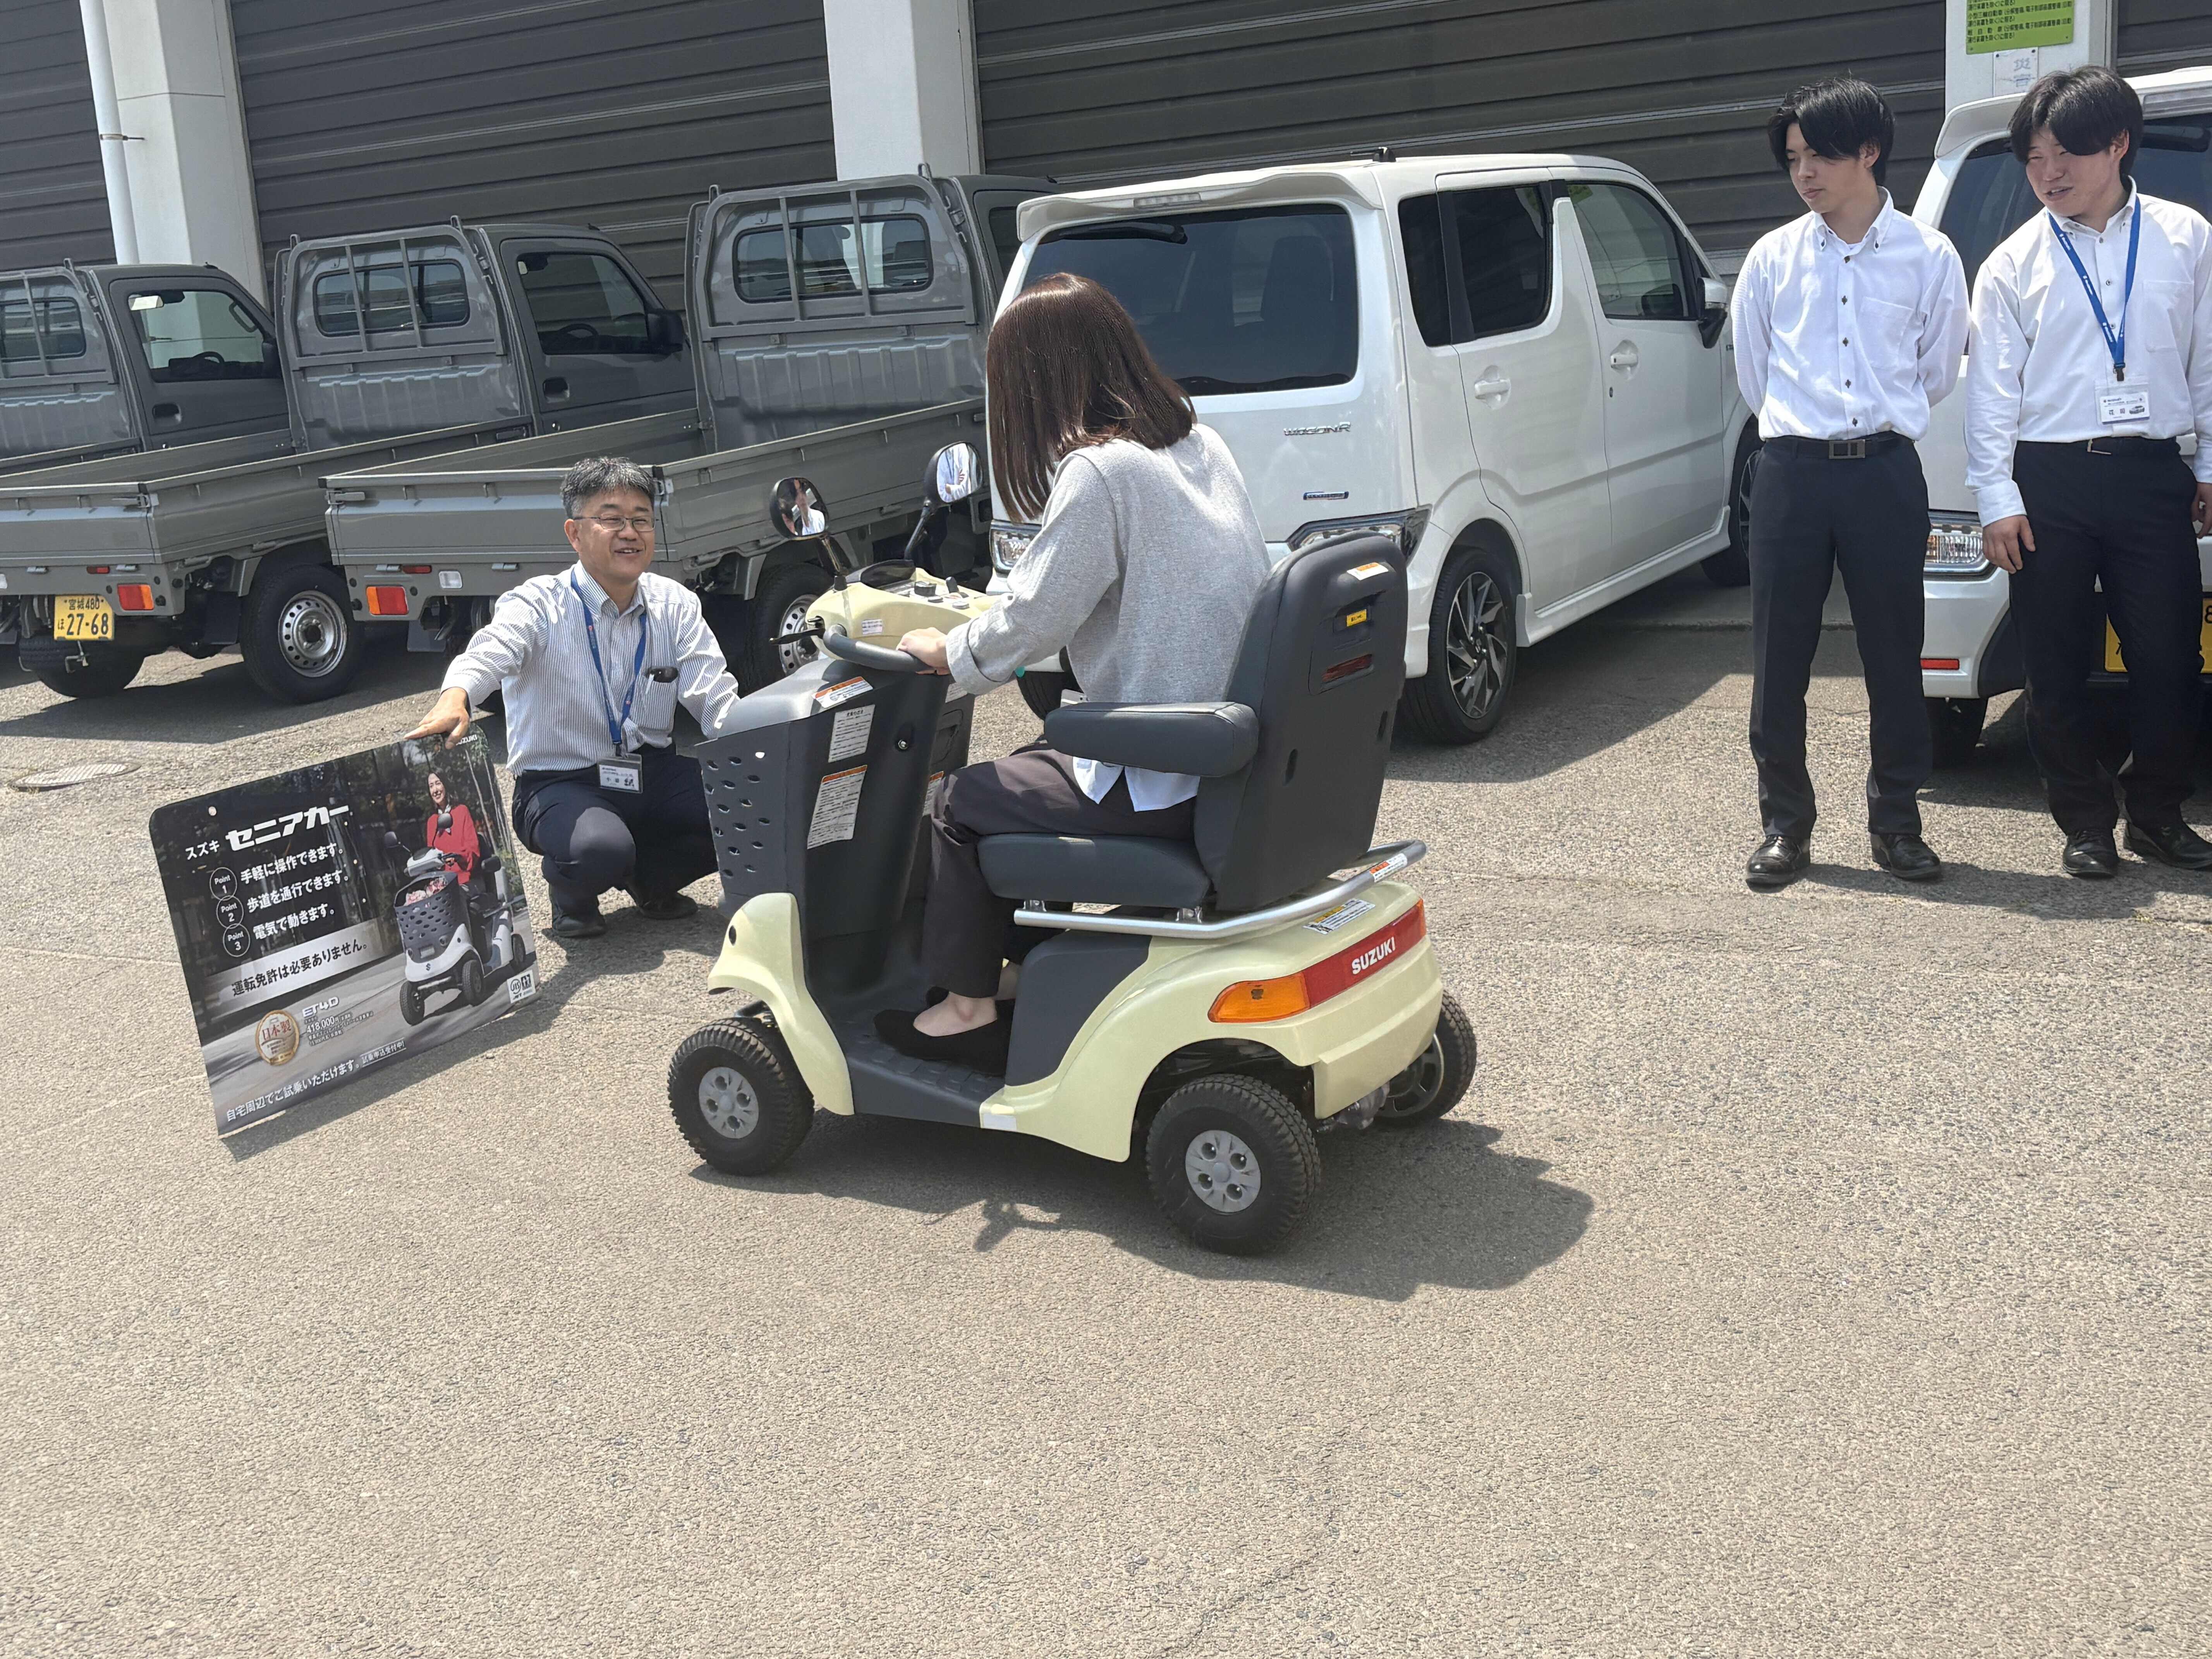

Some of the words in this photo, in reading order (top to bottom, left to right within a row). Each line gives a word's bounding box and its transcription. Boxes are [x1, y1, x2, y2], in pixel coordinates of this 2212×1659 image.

[67, 613, 108, 635] 27-68
[185, 840, 220, 860] スズキ
[225, 805, 349, 852] セニアカー
[240, 842, 343, 884] 手軽に操作できます。
[214, 874, 231, 885] Point
[222, 885, 227, 894] 1
[247, 869, 349, 914] 歩道を通行できます。
[221, 903, 237, 914] Point
[228, 913, 235, 922] 2
[252, 903, 335, 940] 電気で動きます。
[227, 931, 244, 941] Point
[234, 941, 241, 951] 3
[1352, 936, 1396, 975] SUZUKI
[232, 939, 367, 997] 運転免許は必要ありません。
[263, 1019, 291, 1041] 日本製
[226, 1059, 360, 1122] 自宅周辺でご試乗いただけます。
